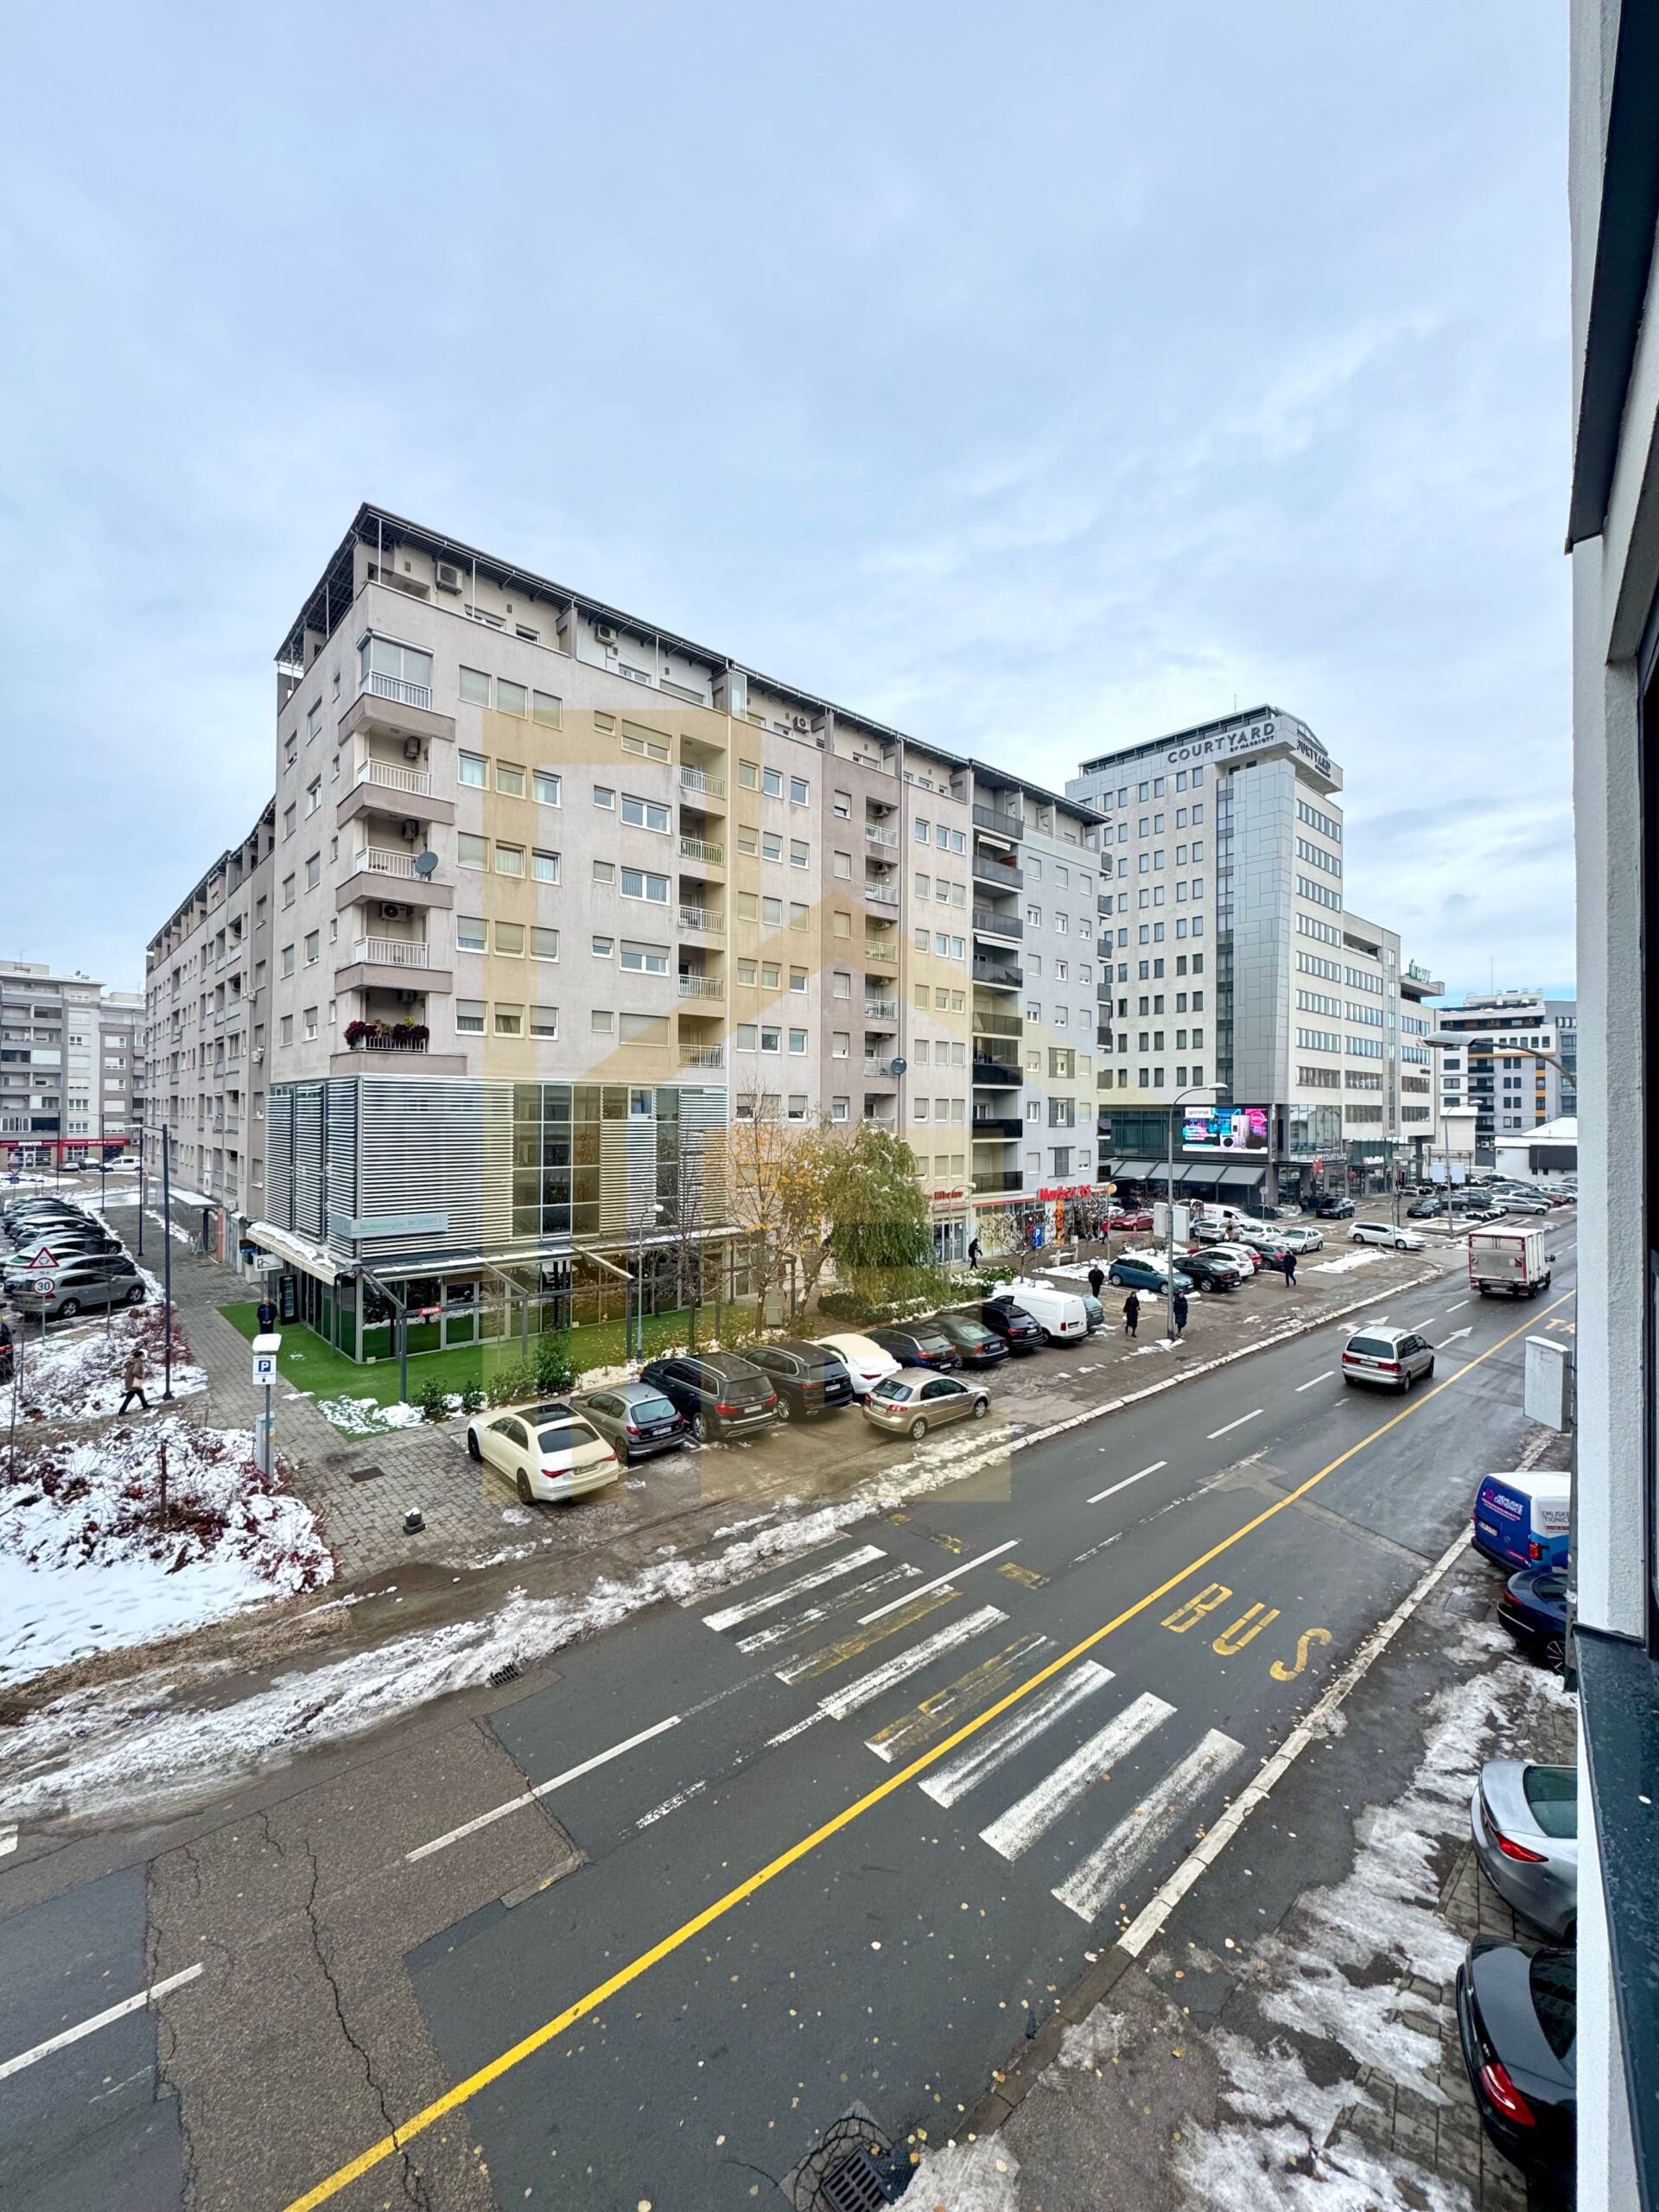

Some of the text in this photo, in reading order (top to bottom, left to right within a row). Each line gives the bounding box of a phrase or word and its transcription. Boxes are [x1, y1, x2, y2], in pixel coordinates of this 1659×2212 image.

[1167, 722, 1274, 764] COURTYARD
[1240, 735, 1274, 749] MARRIOTT
[37, 1282, 51, 1291] 30
[261, 1361, 270, 1371] P
[1160, 1582, 1333, 1682] BUS
